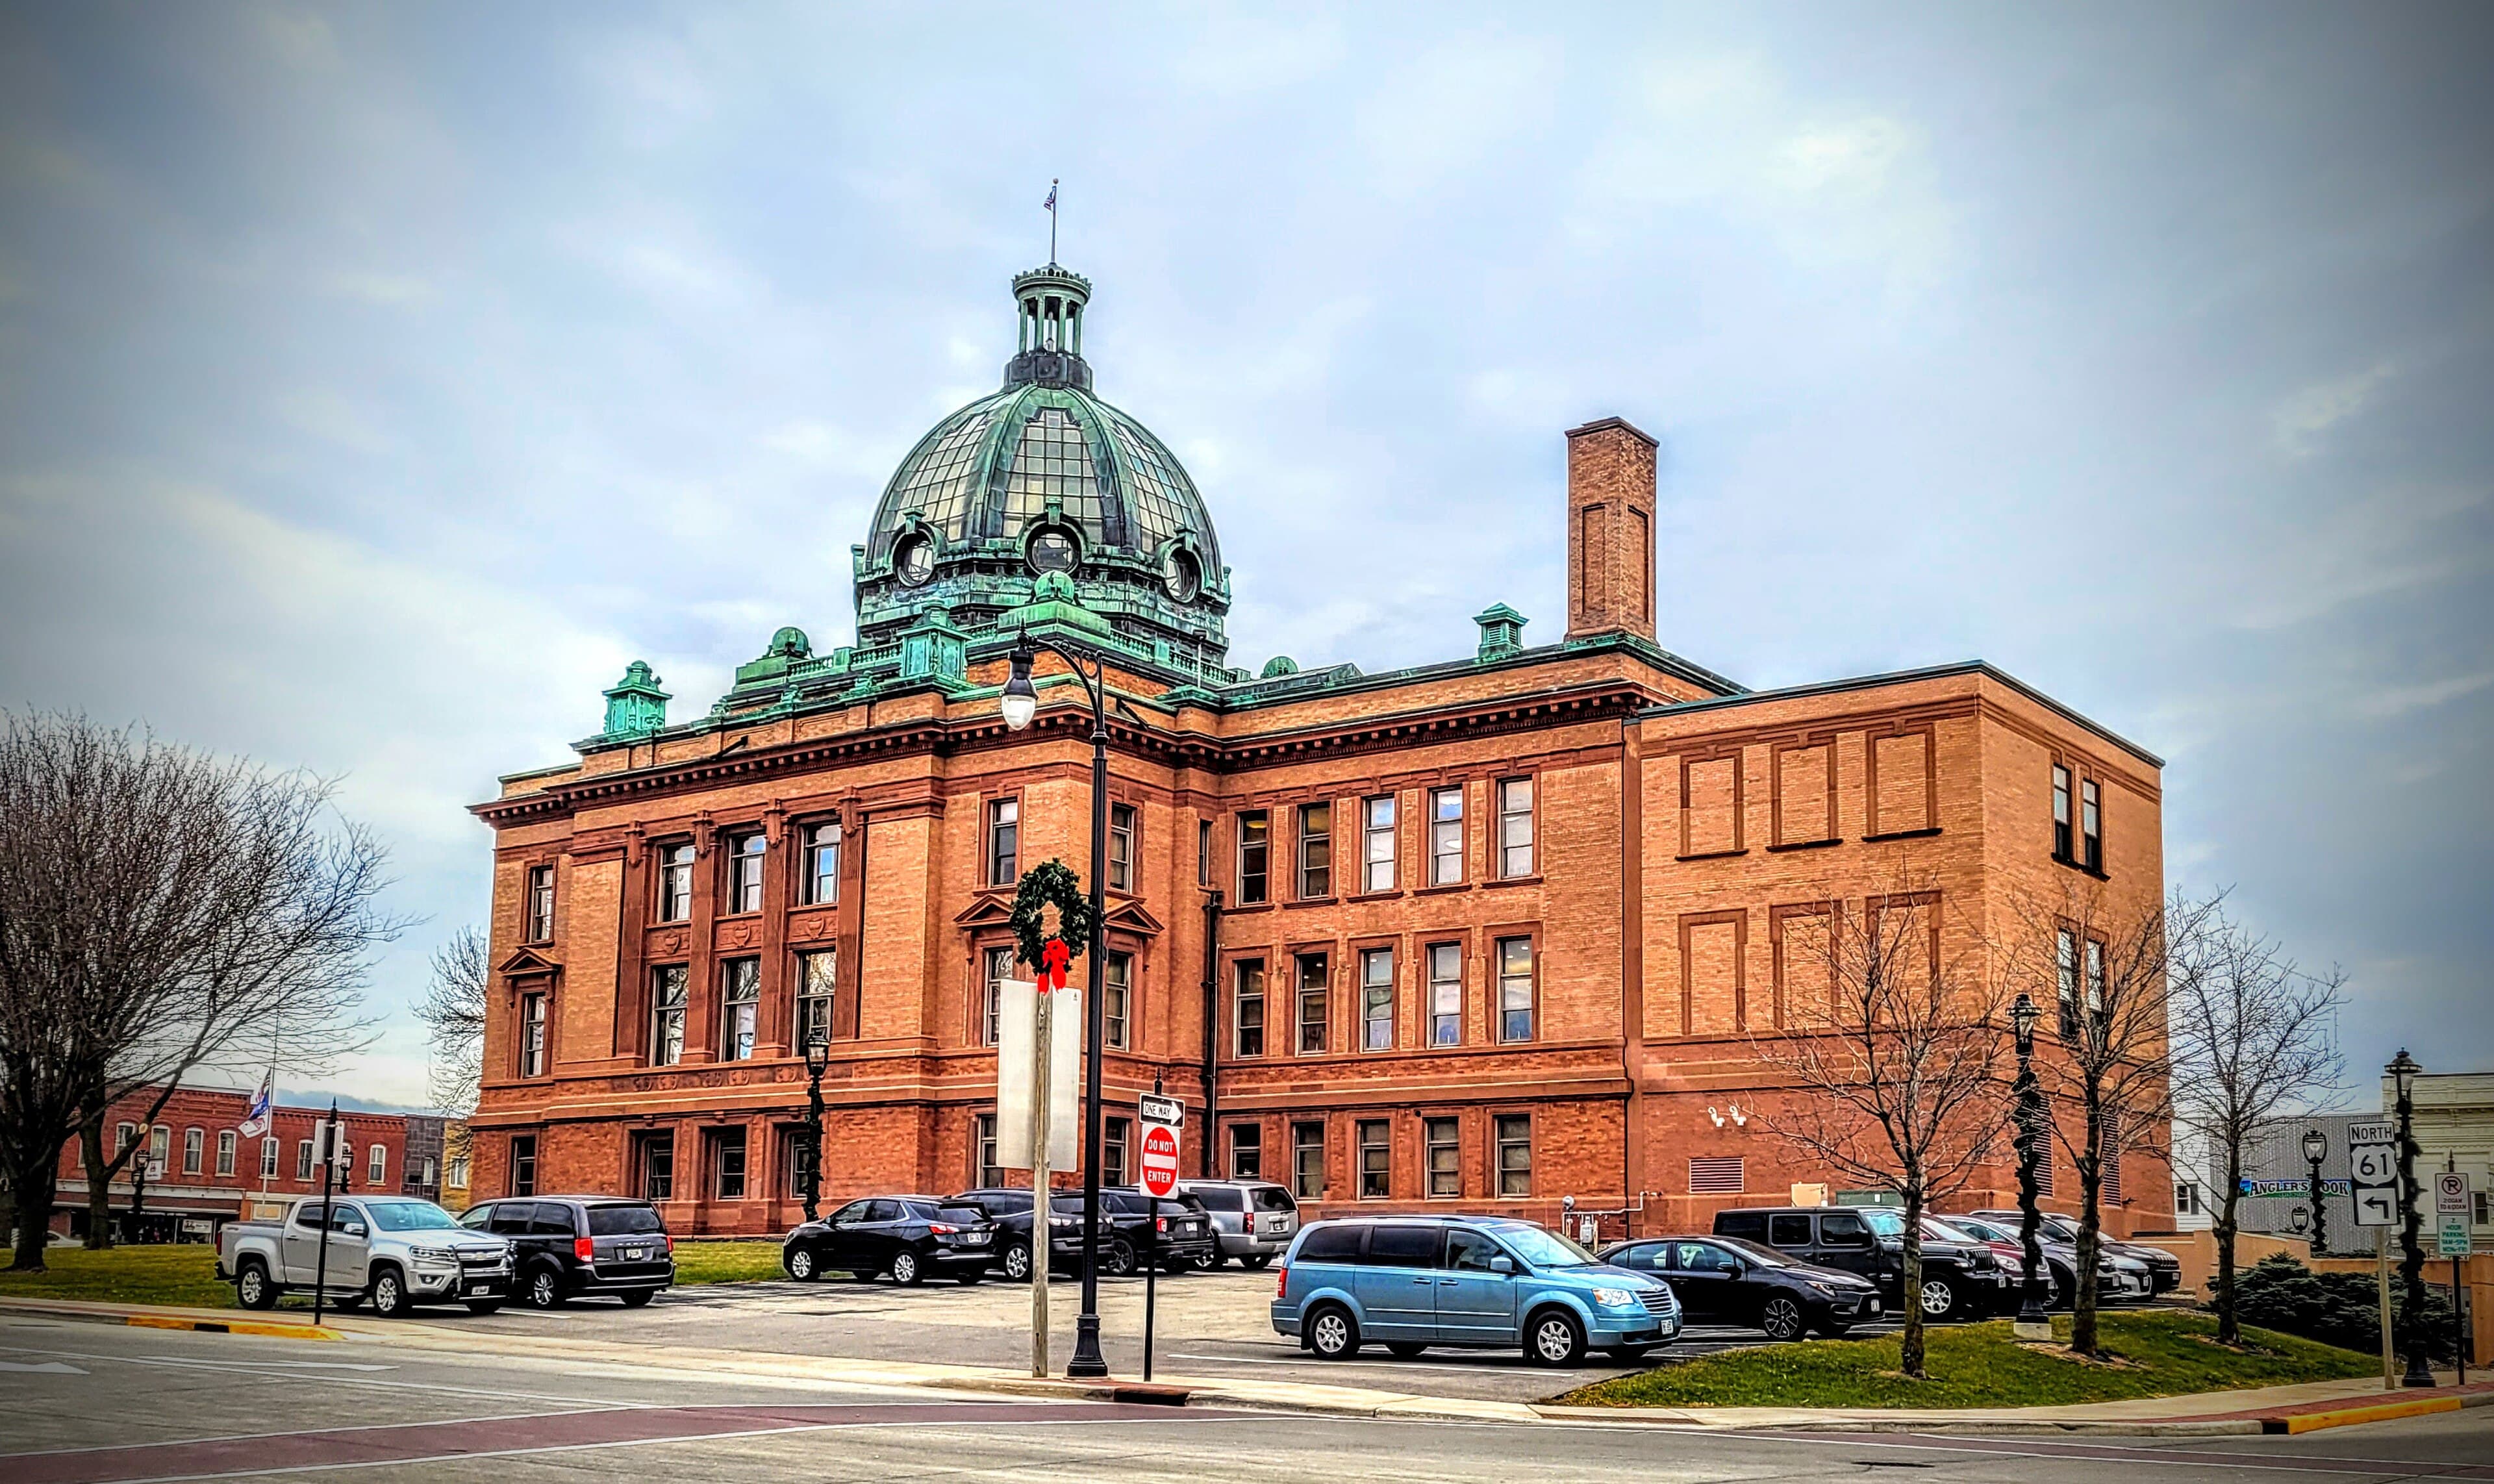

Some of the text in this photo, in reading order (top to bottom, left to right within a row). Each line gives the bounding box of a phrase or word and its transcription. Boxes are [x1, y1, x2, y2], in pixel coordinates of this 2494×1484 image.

[1144, 1103, 1171, 1118] ONE WAY
[2352, 1126, 2392, 1140] NORTH
[1148, 1138, 1174, 1153] DO NOT
[2360, 1153, 2387, 1176] 61
[1147, 1170, 1171, 1183] ENTER
